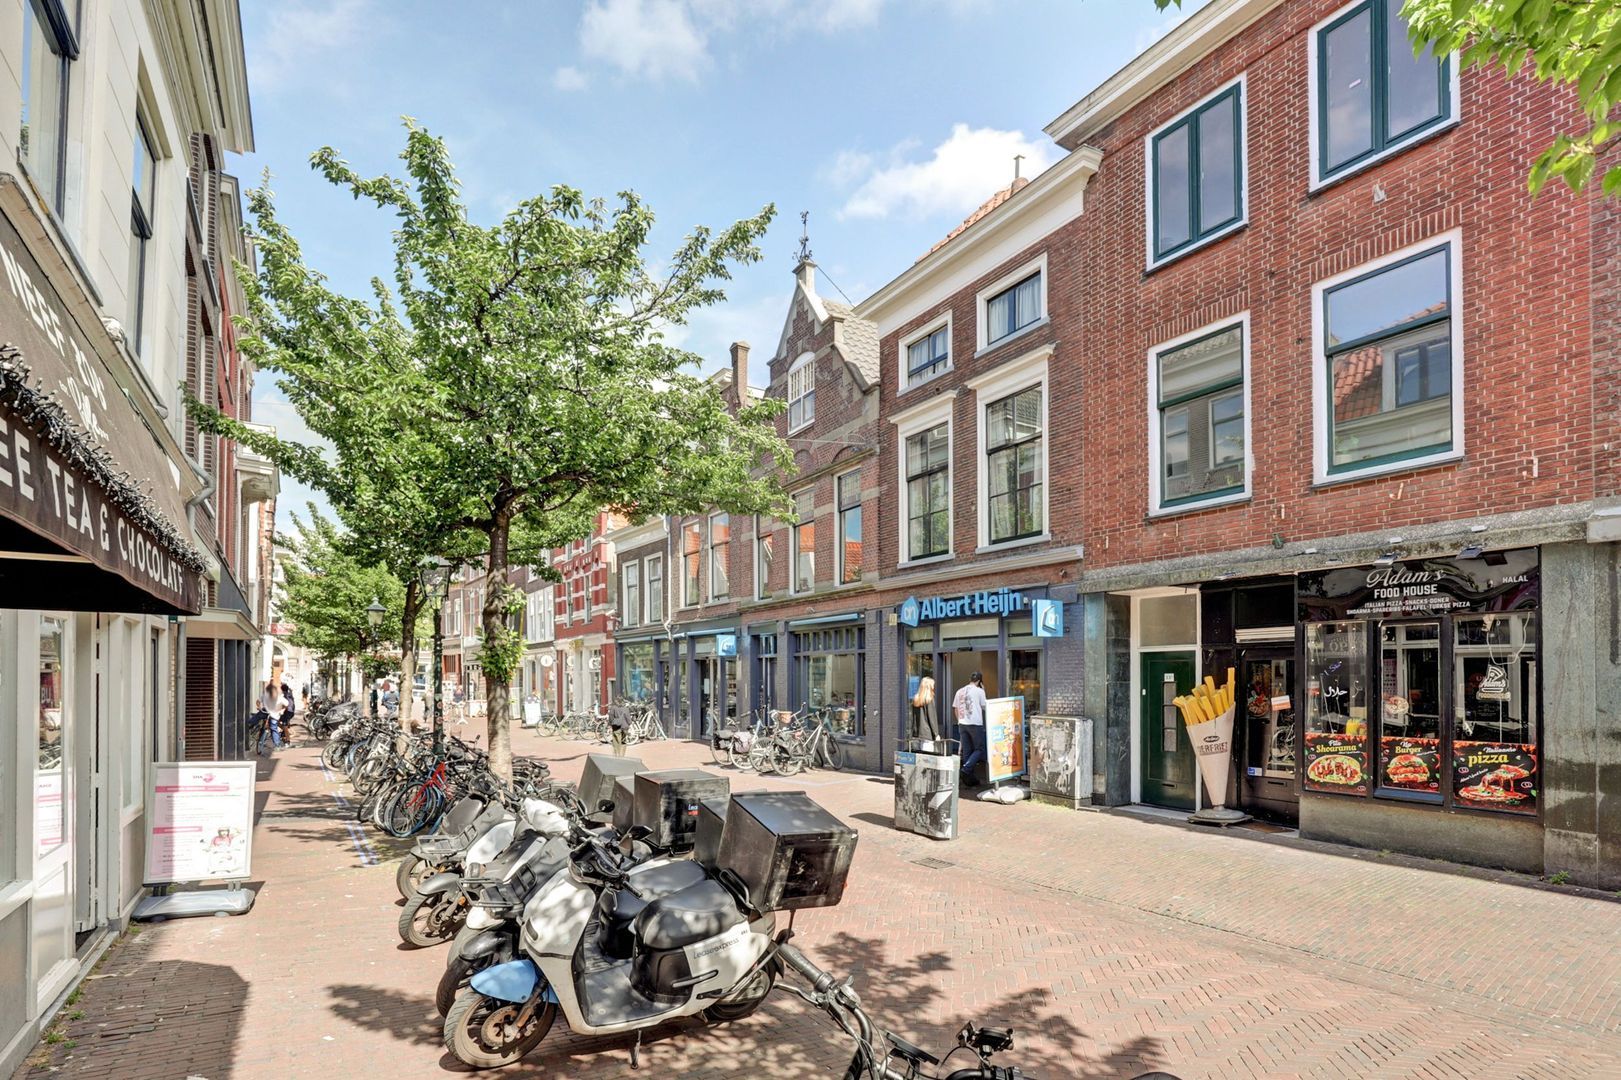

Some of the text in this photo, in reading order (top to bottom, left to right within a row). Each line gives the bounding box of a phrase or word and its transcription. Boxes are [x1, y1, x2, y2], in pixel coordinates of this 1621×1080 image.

[46, 455, 94, 541] TEA
[100, 503, 110, 551] &
[1502, 575, 1529, 584] HALAL
[1374, 584, 1438, 599] FOOD HOUSE
[920, 587, 1022, 620] Albert Heijn
[1315, 744, 1357, 753] Shoarama
[1395, 746, 1423, 755] Burger
[1468, 751, 1509, 767] pizza
